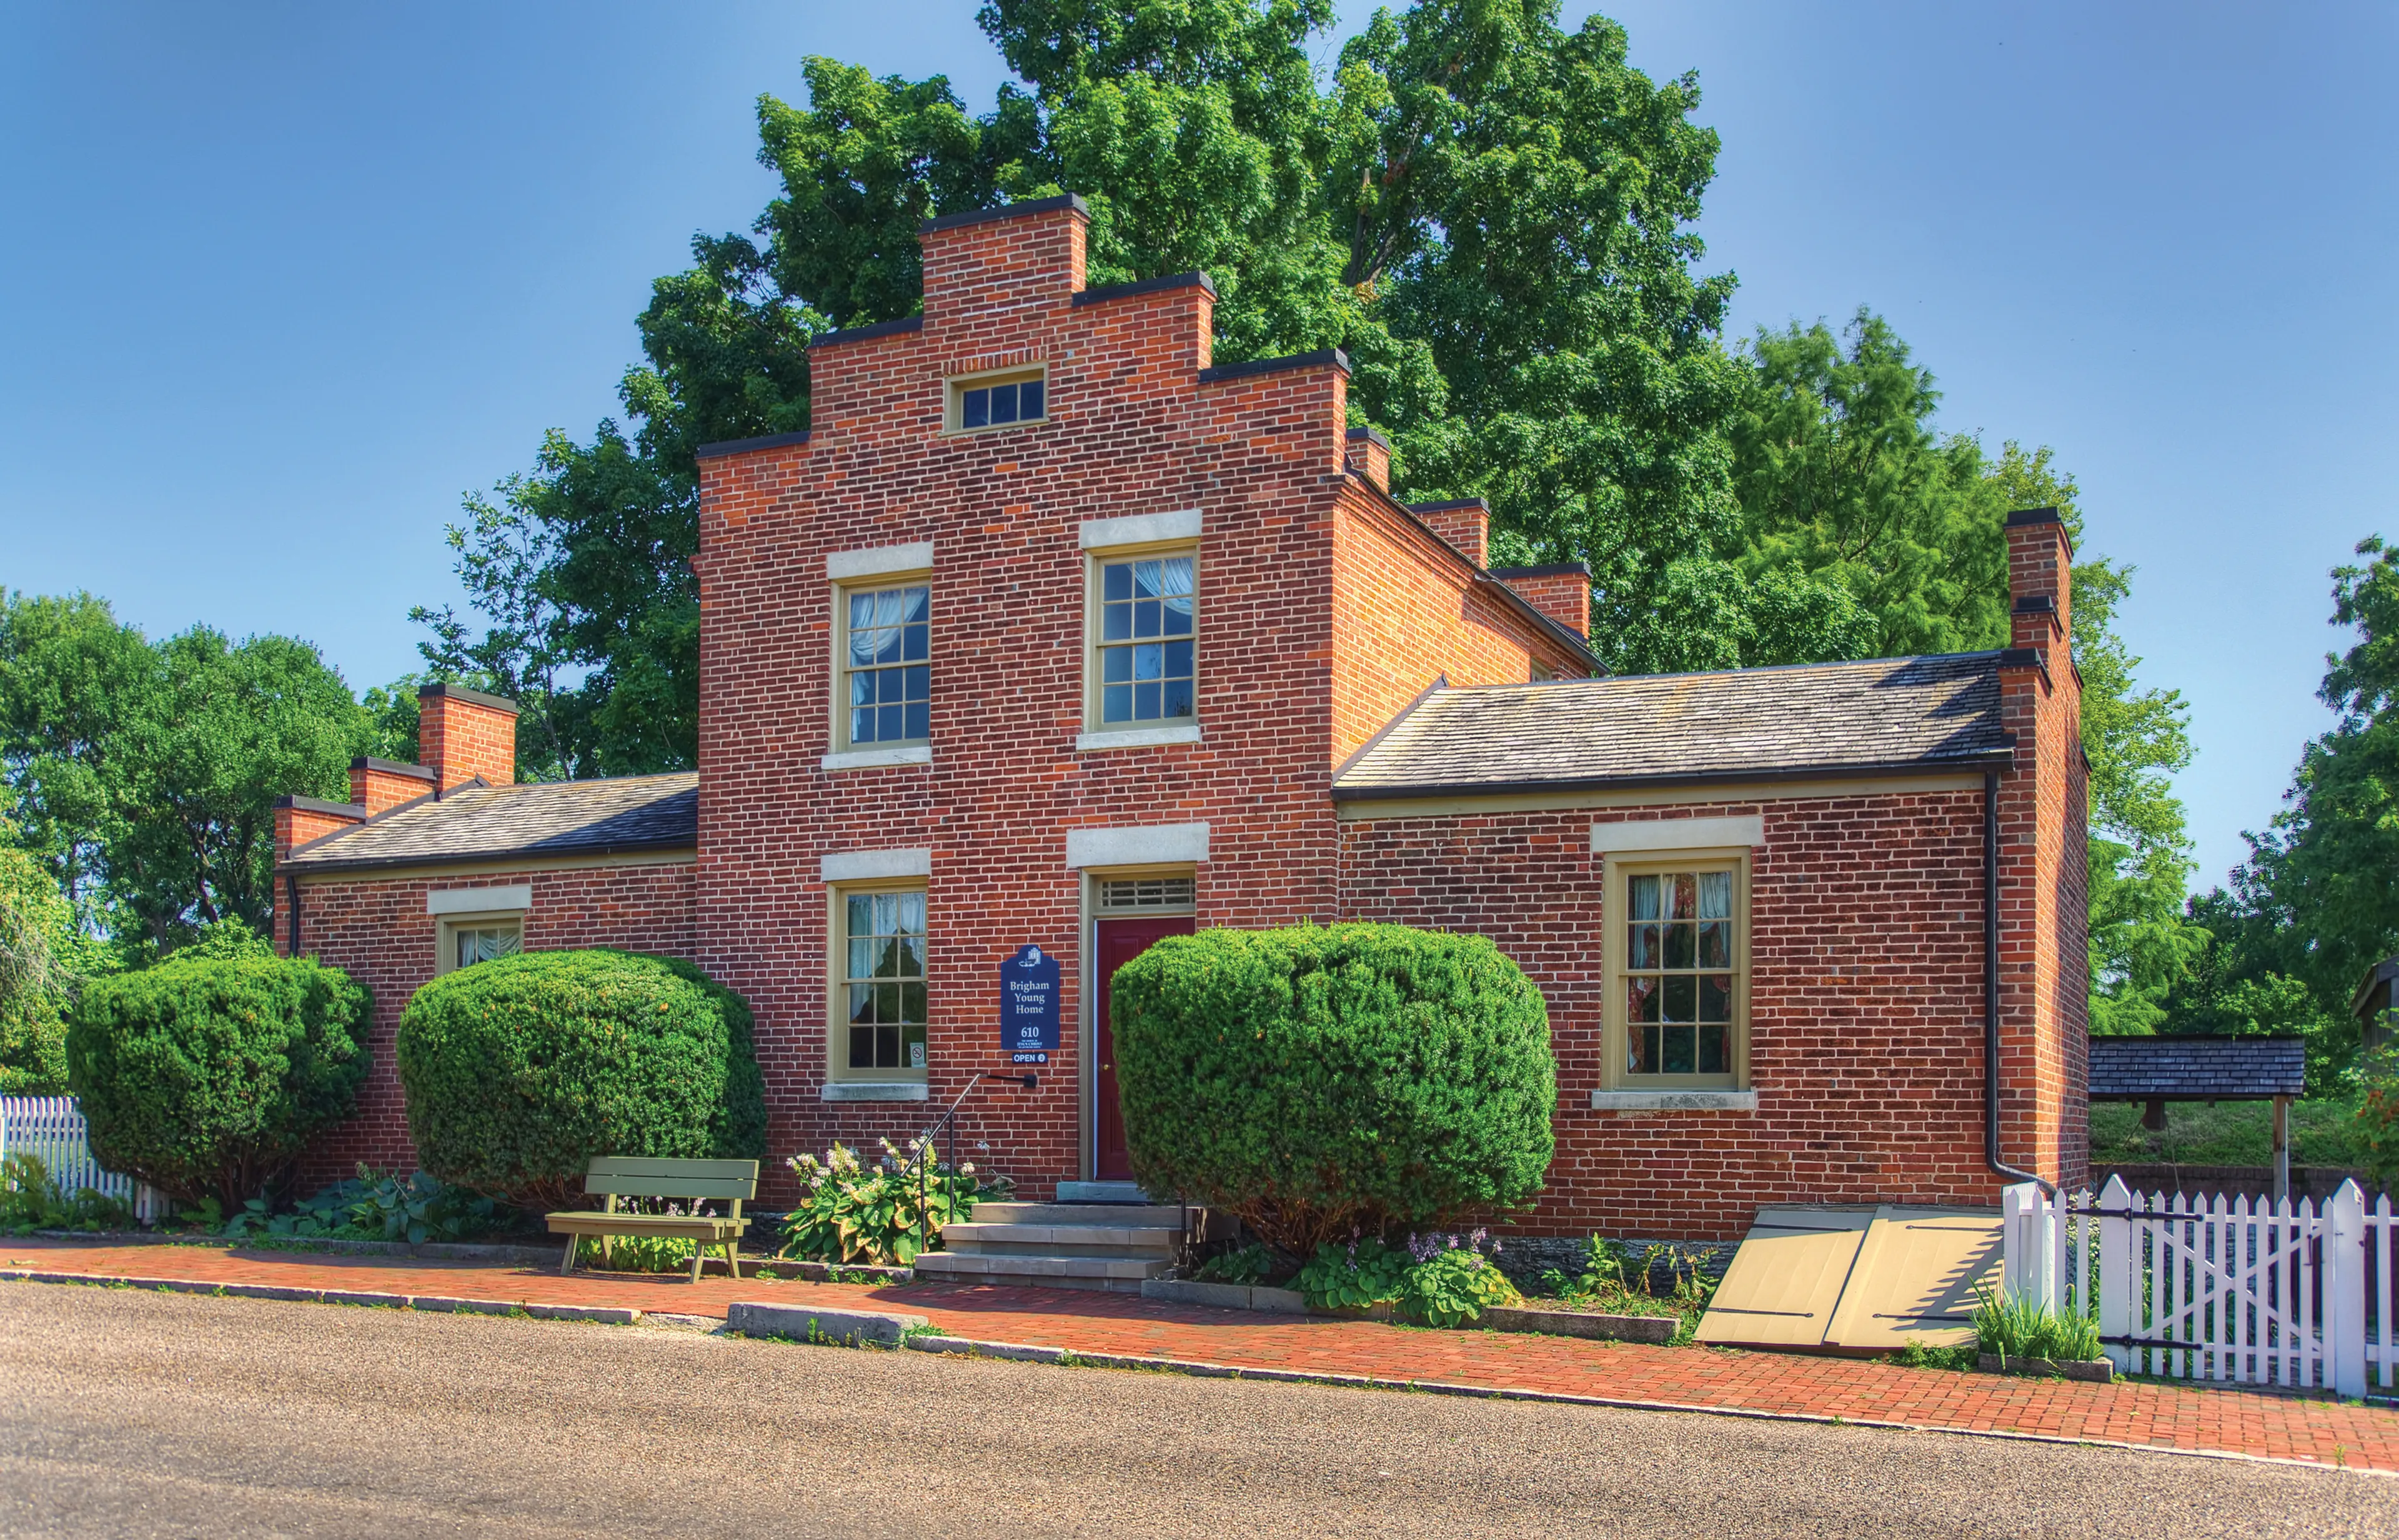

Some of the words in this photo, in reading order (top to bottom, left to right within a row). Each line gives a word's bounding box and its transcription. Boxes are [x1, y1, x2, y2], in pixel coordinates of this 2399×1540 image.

[1010, 981, 1050, 993] Brigham
[1015, 993, 1045, 1004] Young
[1016, 1005, 1044, 1013] Home
[1021, 1026, 1039, 1037] 610
